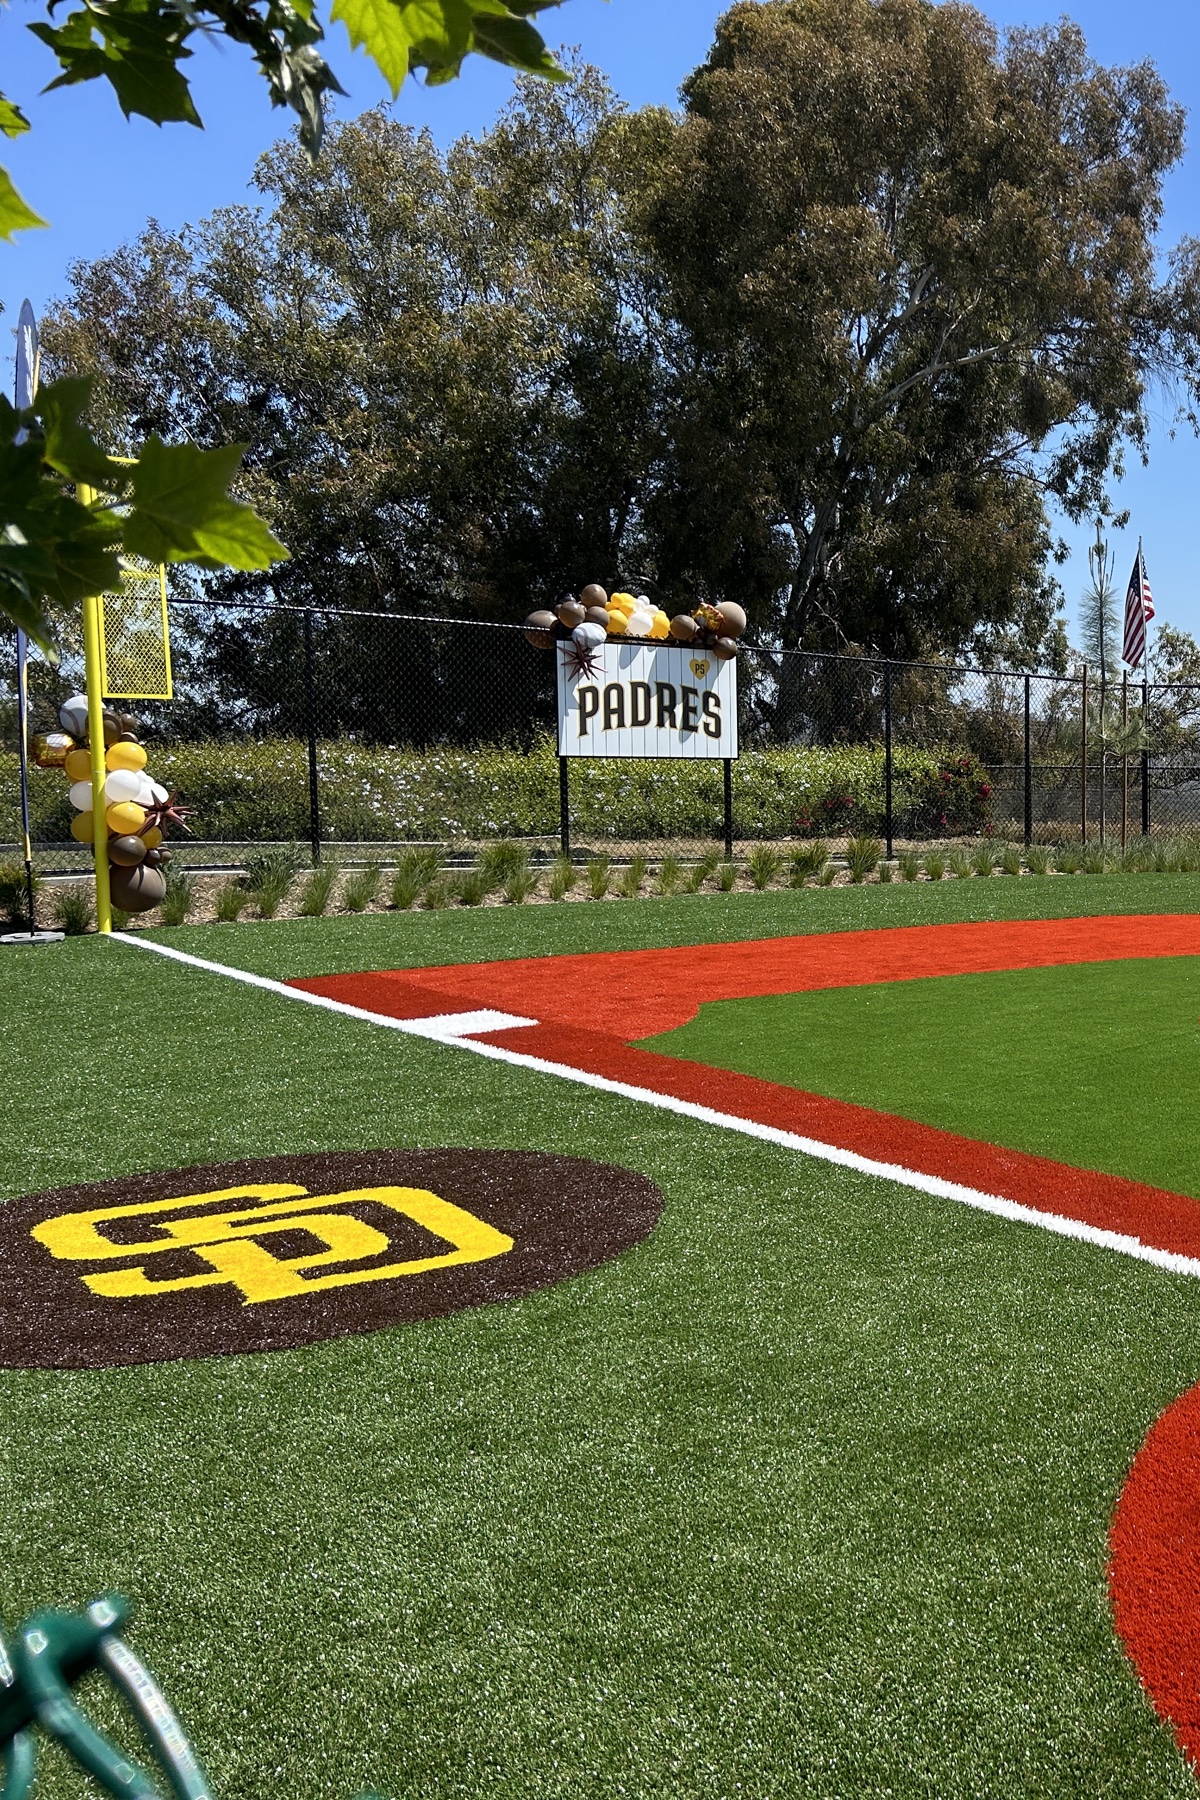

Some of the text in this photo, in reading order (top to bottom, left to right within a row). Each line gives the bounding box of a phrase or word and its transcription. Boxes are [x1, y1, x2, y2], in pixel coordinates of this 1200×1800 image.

[695, 663, 705, 675] PS
[577, 680, 722, 739] PADRES
[30, 1183, 514, 1306] SD
